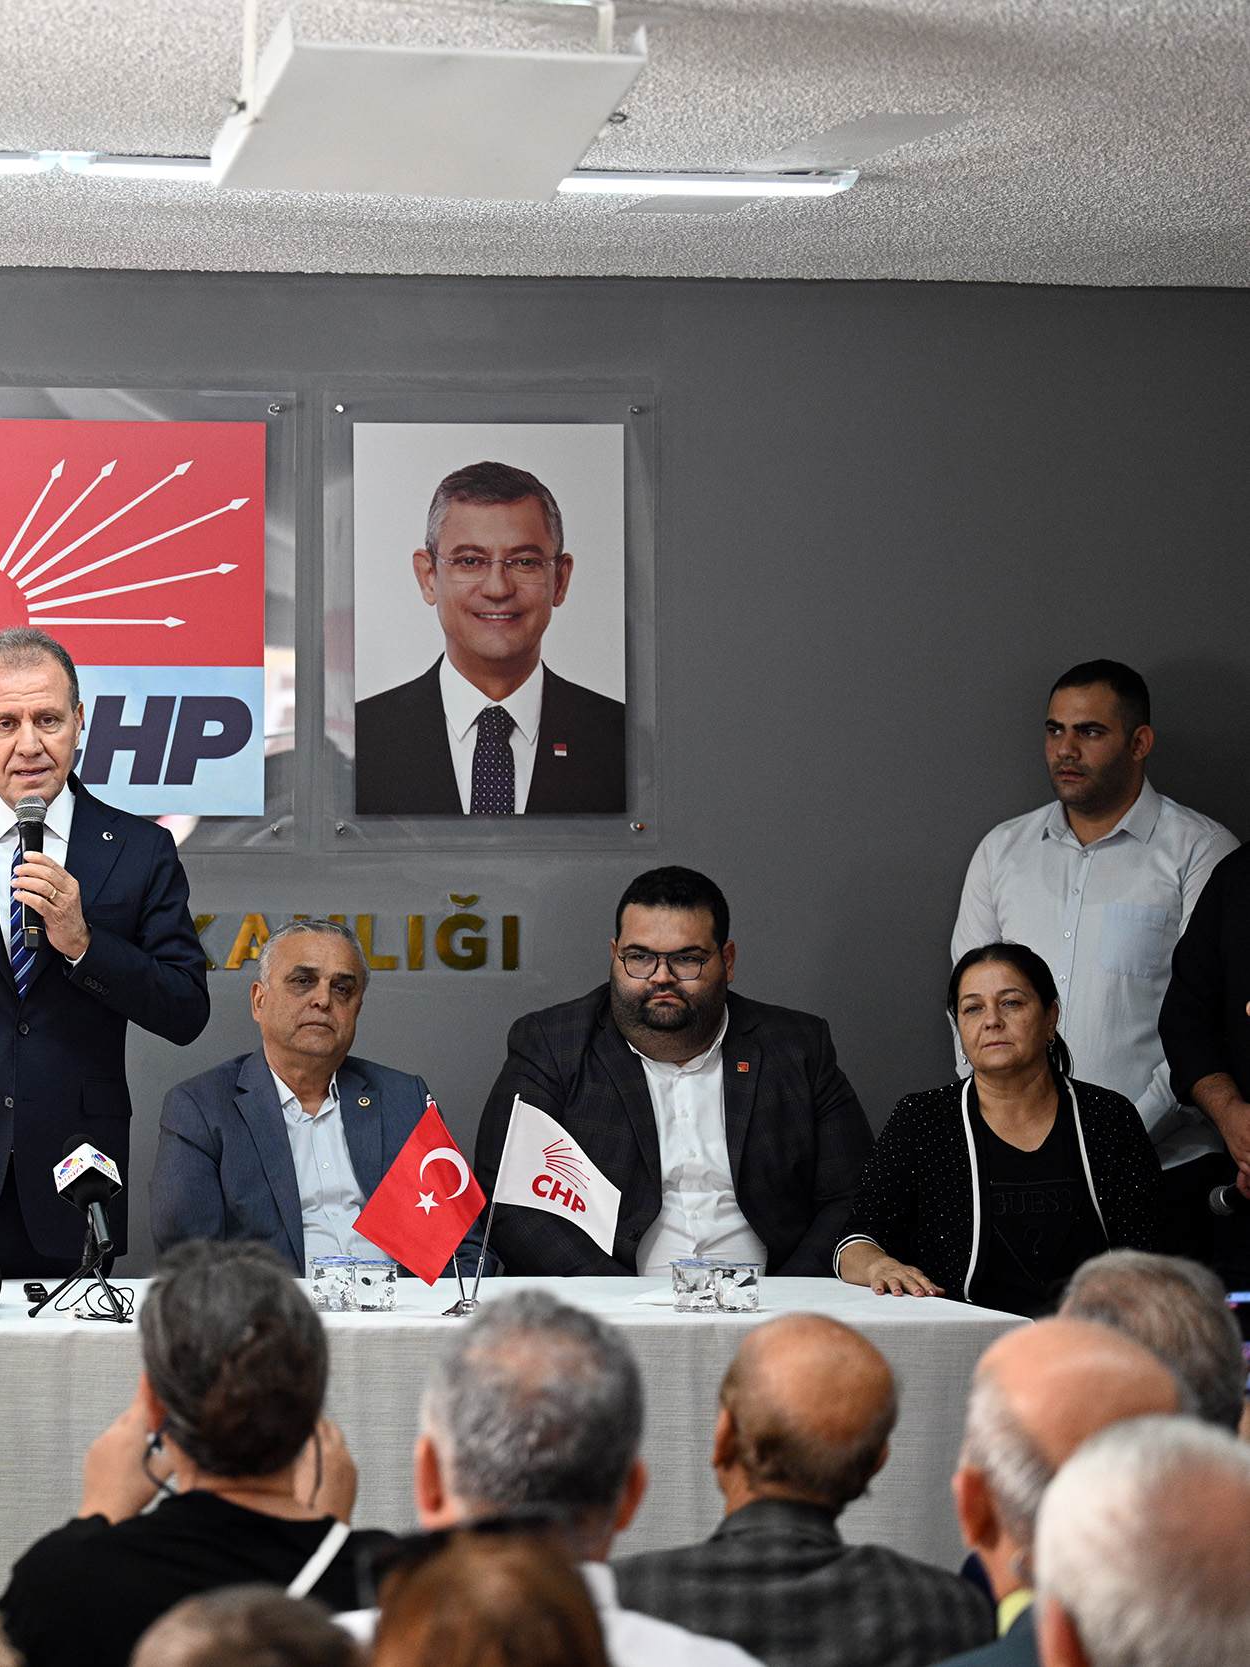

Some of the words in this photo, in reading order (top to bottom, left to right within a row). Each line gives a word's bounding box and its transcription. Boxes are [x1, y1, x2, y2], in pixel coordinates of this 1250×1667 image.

[73, 695, 253, 785] HP
[532, 1174, 586, 1213] CHP
[991, 1188, 1073, 1216] GUESS
